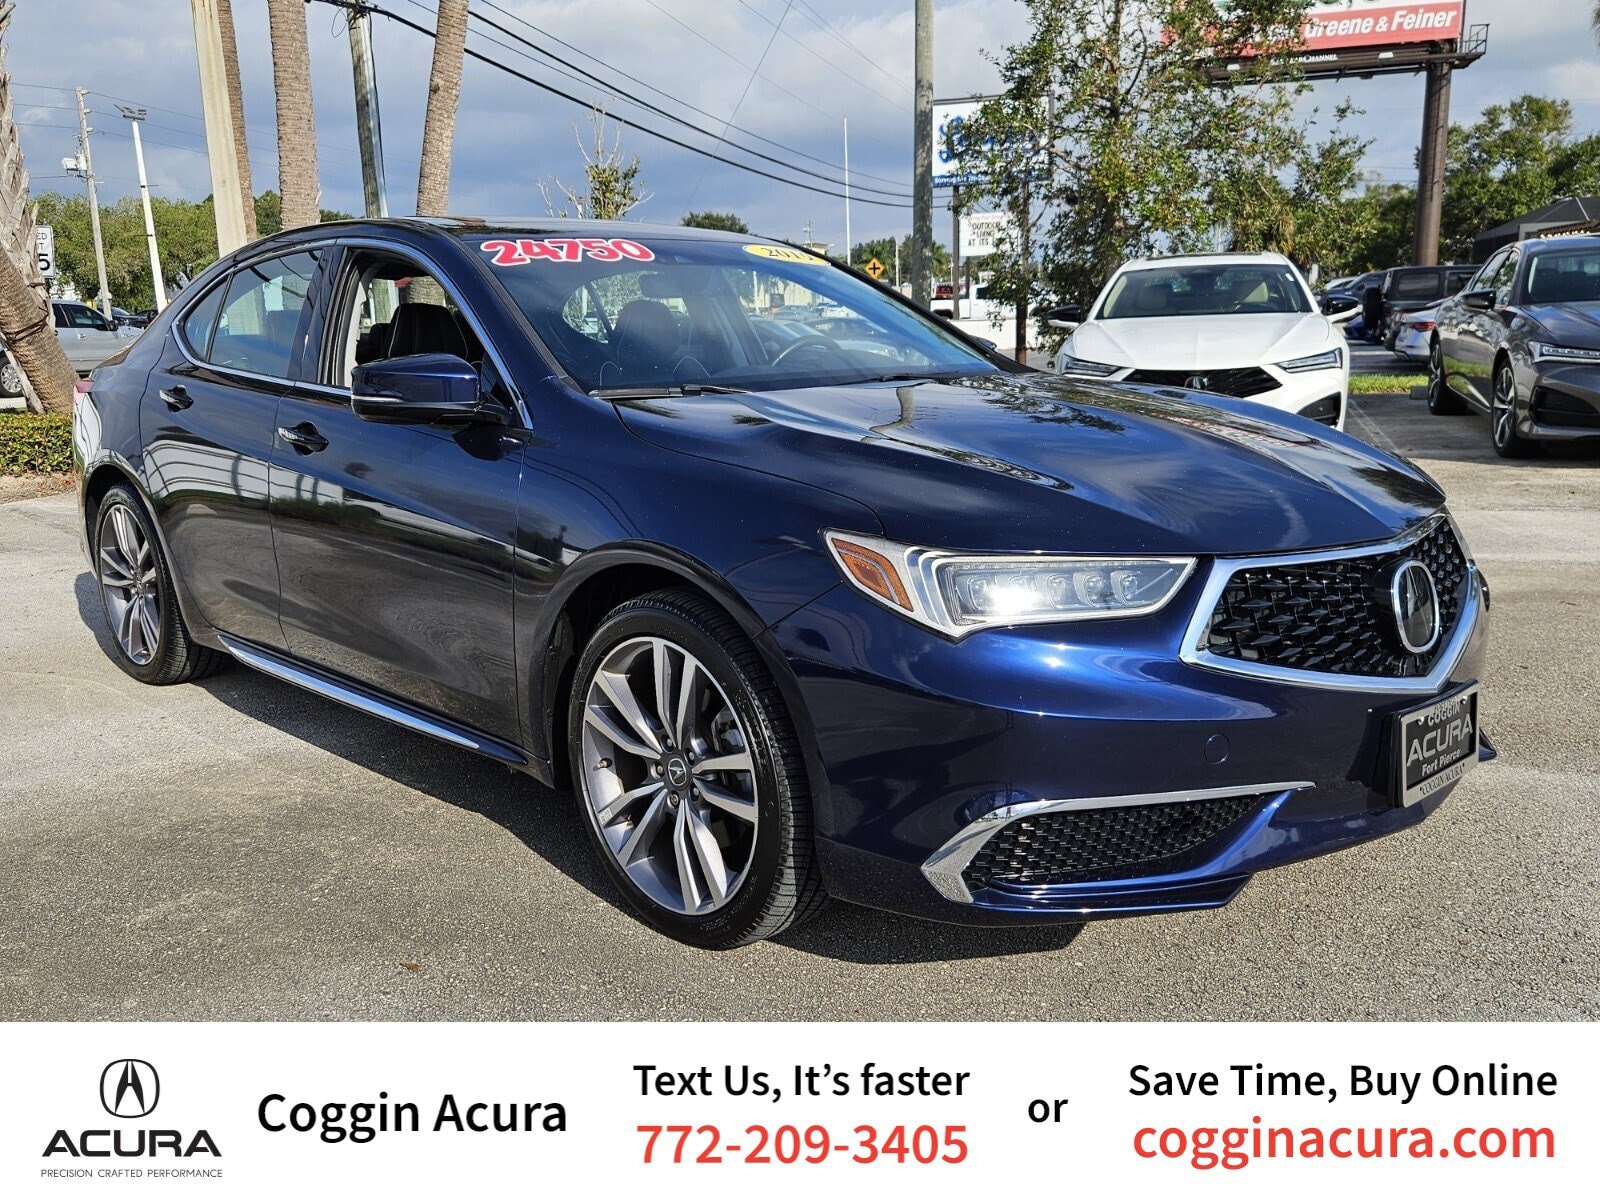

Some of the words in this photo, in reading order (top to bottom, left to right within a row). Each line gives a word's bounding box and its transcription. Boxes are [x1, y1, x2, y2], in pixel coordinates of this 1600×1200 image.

[1304, 16, 1375, 38] Greene
[1375, 16, 1389, 32] &
[1391, 9, 1457, 31] Feiner
[38, 253, 50, 271] 5
[480, 239, 655, 266] 24750
[1428, 702, 1460, 726] COGGIN
[1407, 713, 1473, 767] ACURA
[1422, 758, 1437, 776] Fort
[1440, 749, 1460, 768] Pierce
